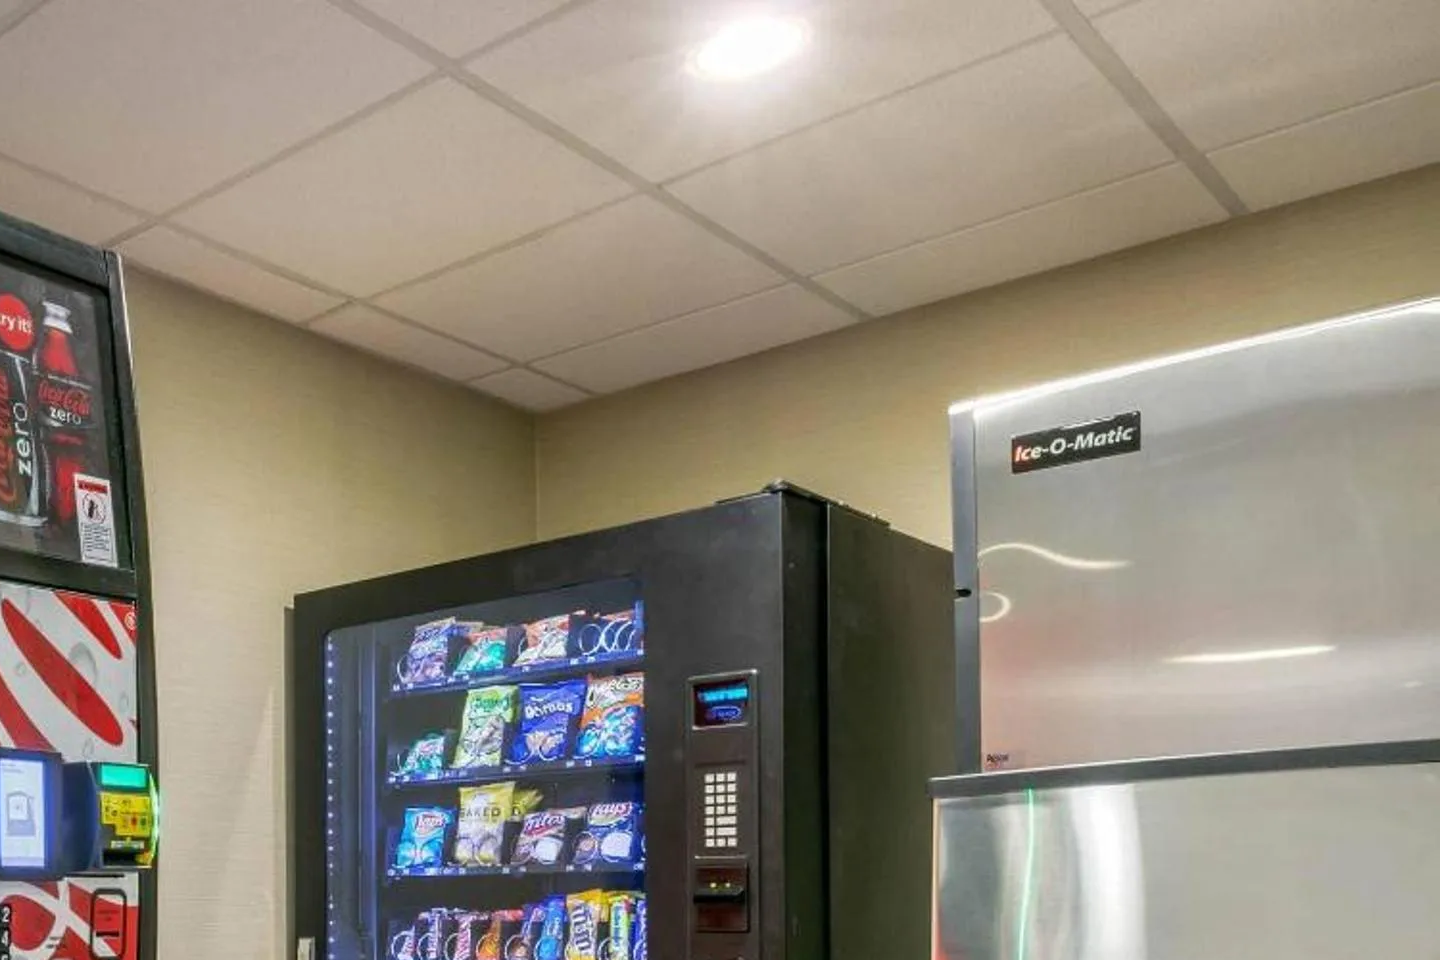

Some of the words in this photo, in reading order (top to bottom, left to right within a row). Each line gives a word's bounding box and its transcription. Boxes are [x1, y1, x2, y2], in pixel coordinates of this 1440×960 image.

[49, 406, 82, 426] zero
[13, 402, 32, 477] zero
[1015, 425, 1134, 463] Ice-O-Matic
[2, 906, 10, 923] 2
[1, 930, 10, 947] 4
